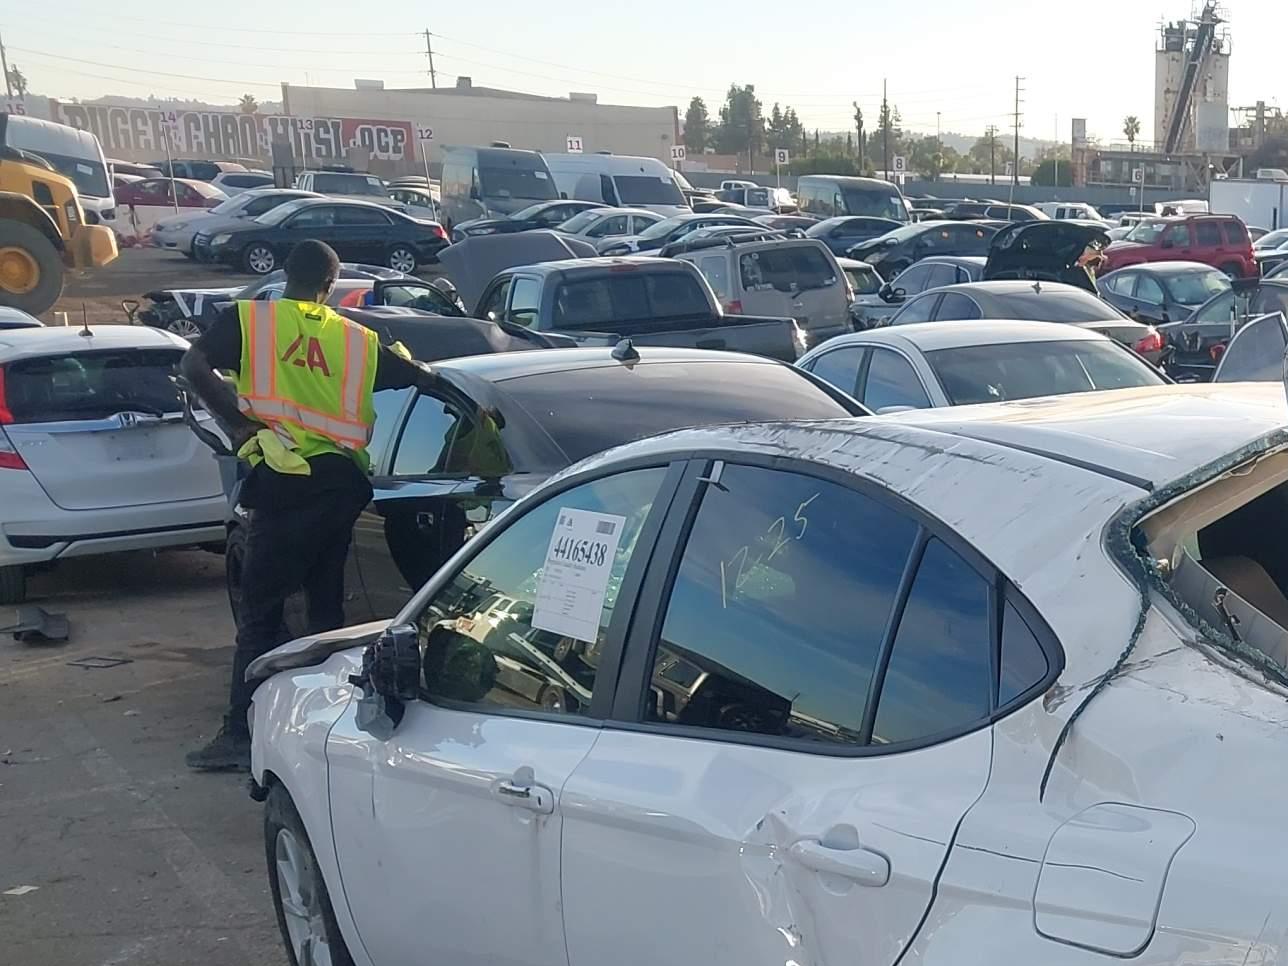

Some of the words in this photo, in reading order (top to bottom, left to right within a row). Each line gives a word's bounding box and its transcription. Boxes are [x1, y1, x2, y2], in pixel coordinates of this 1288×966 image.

[160, 111, 176, 123] 14
[298, 119, 313, 130] 13
[418, 128, 433, 140] 12
[567, 139, 582, 151] 11
[671, 147, 685, 159] 10
[778, 151, 786, 163] 9
[896, 158, 903, 169] 8
[1135, 170, 1142, 180] 6
[554, 536, 608, 567] 44165438
